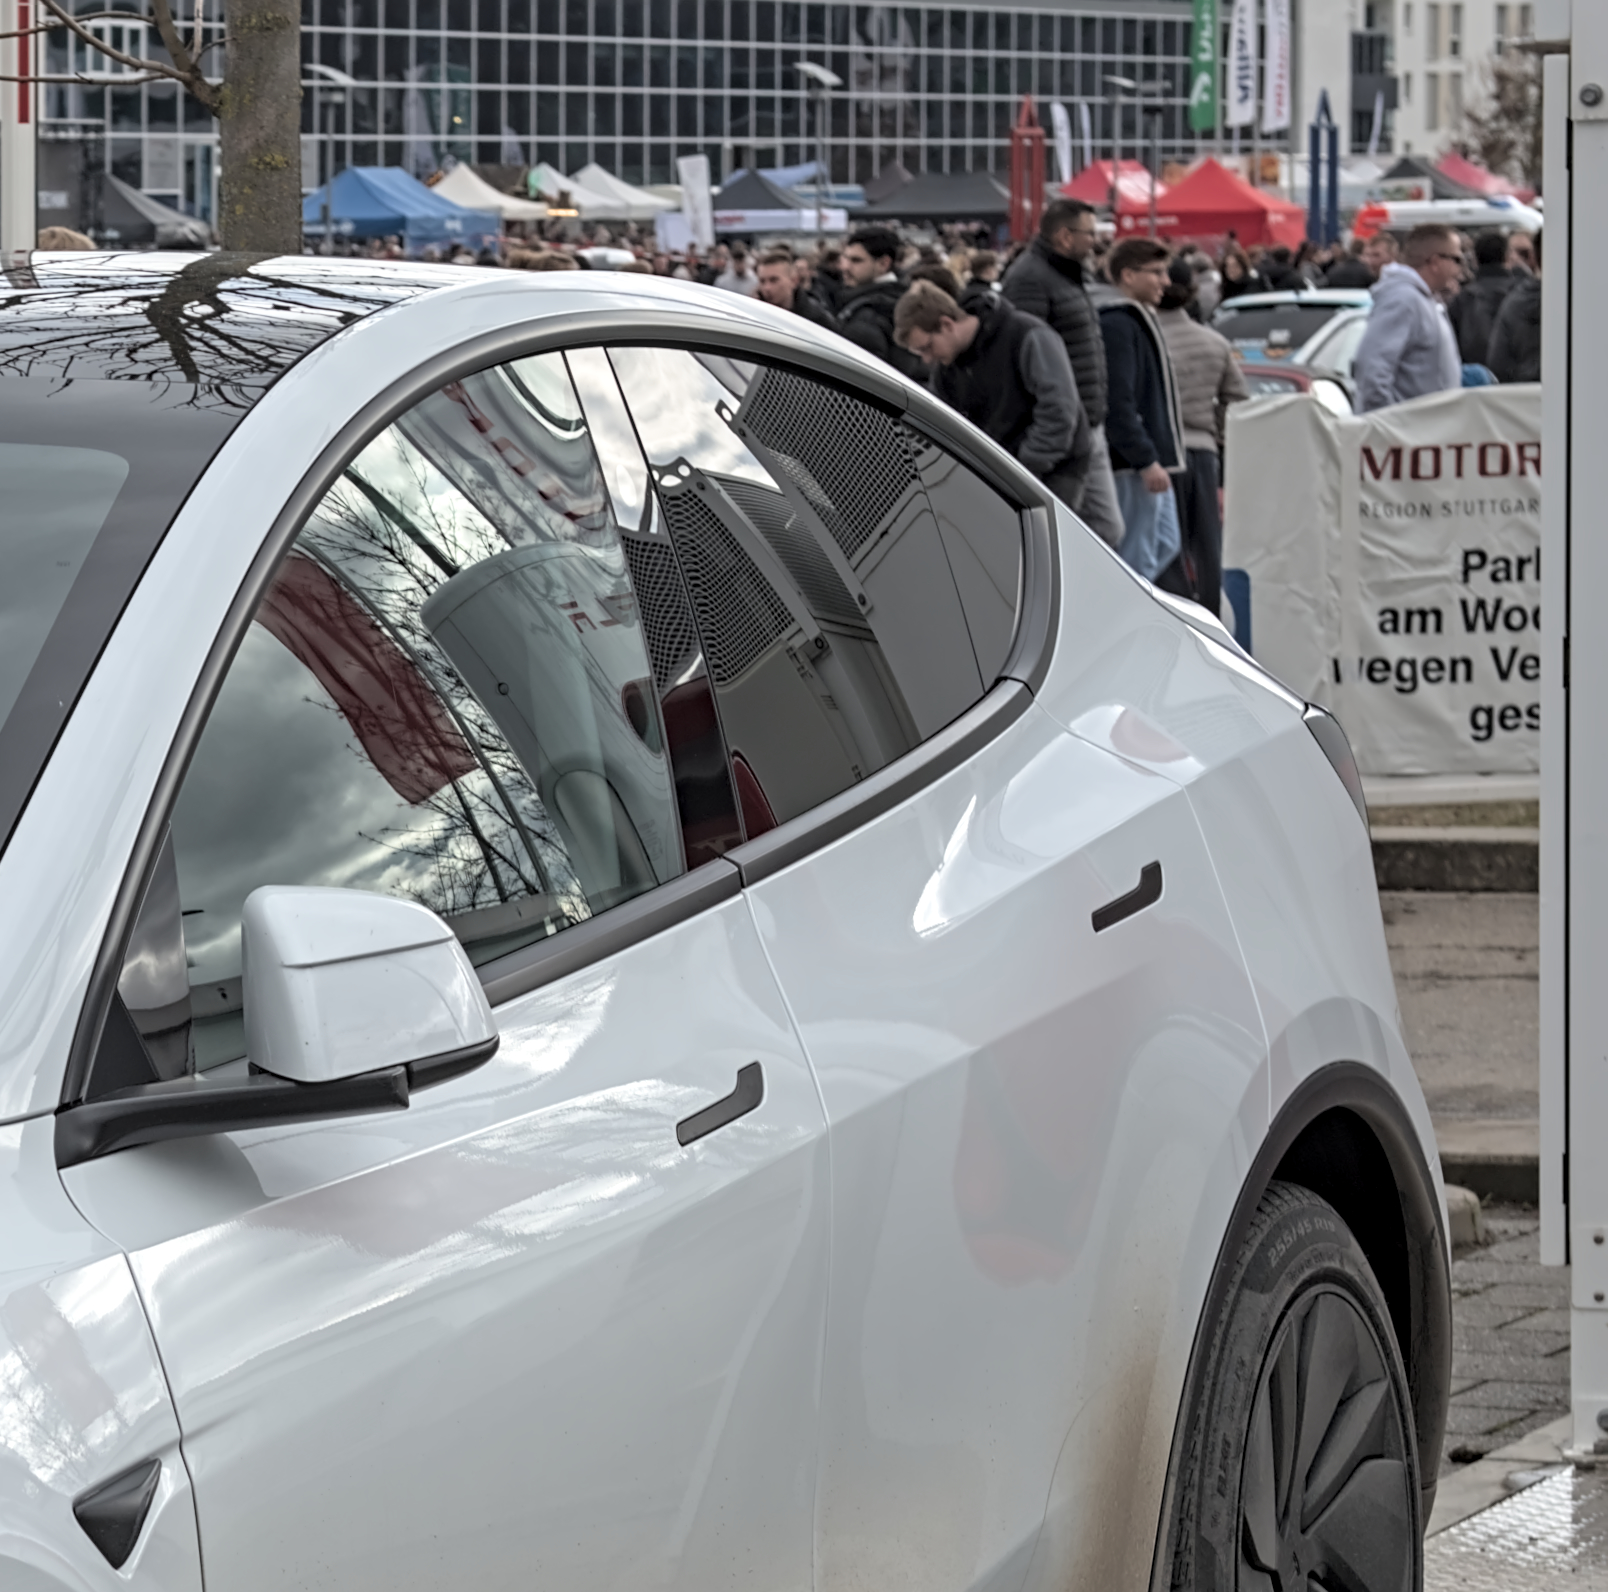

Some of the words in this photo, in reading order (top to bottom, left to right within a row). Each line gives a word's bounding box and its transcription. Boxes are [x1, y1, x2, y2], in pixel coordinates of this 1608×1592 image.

[1360, 441, 1541, 482] MOTOR
[1359, 501, 1433, 520] REGION
[1377, 606, 1444, 635] am
